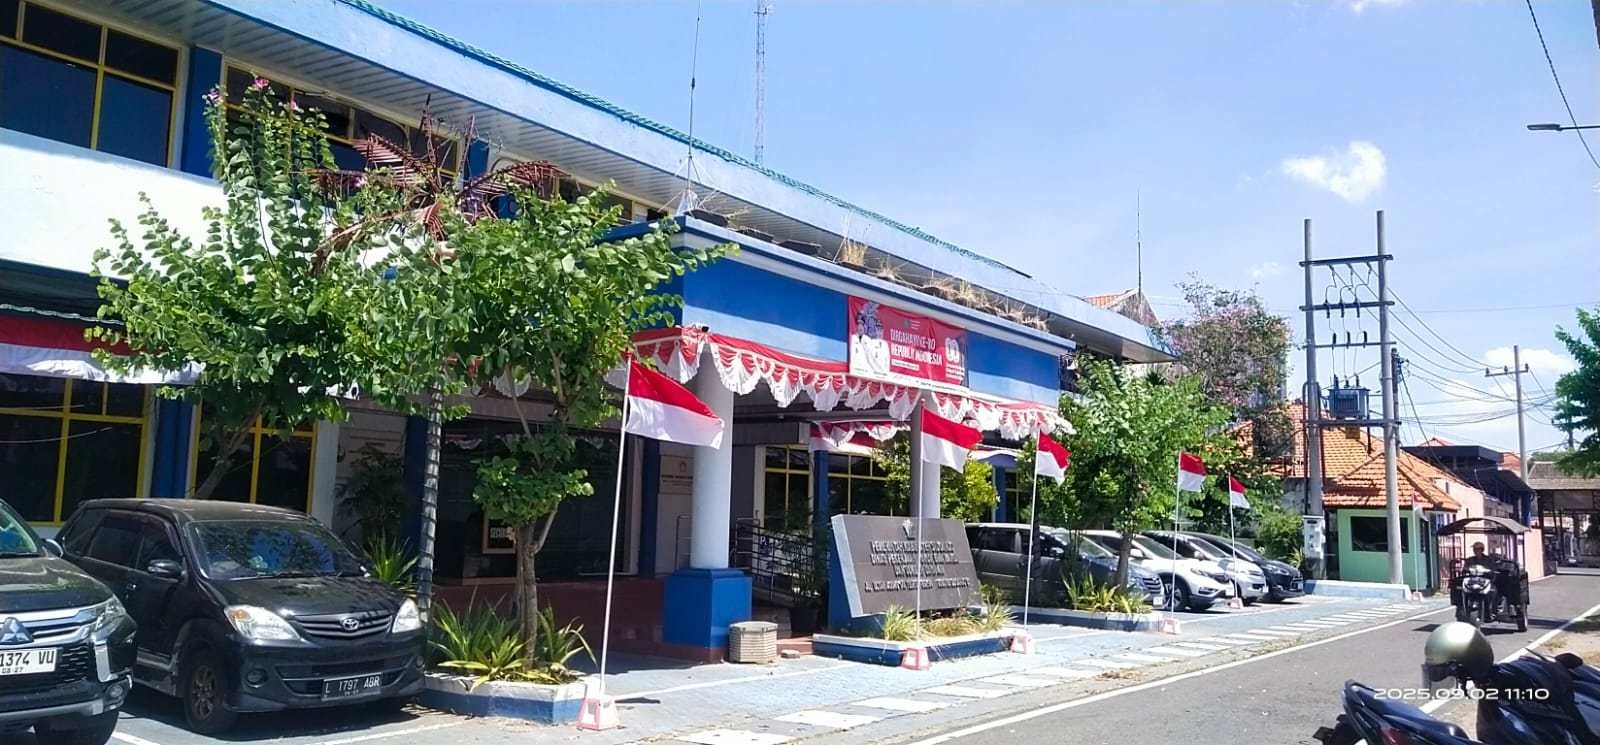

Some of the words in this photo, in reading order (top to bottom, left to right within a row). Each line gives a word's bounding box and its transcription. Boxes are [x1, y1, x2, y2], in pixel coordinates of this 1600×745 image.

[915, 349, 942, 366] INDONESIA
[0, 651, 30, 666] 1374
[39, 650, 54, 664] VU
[338, 679, 358, 691] 1797
